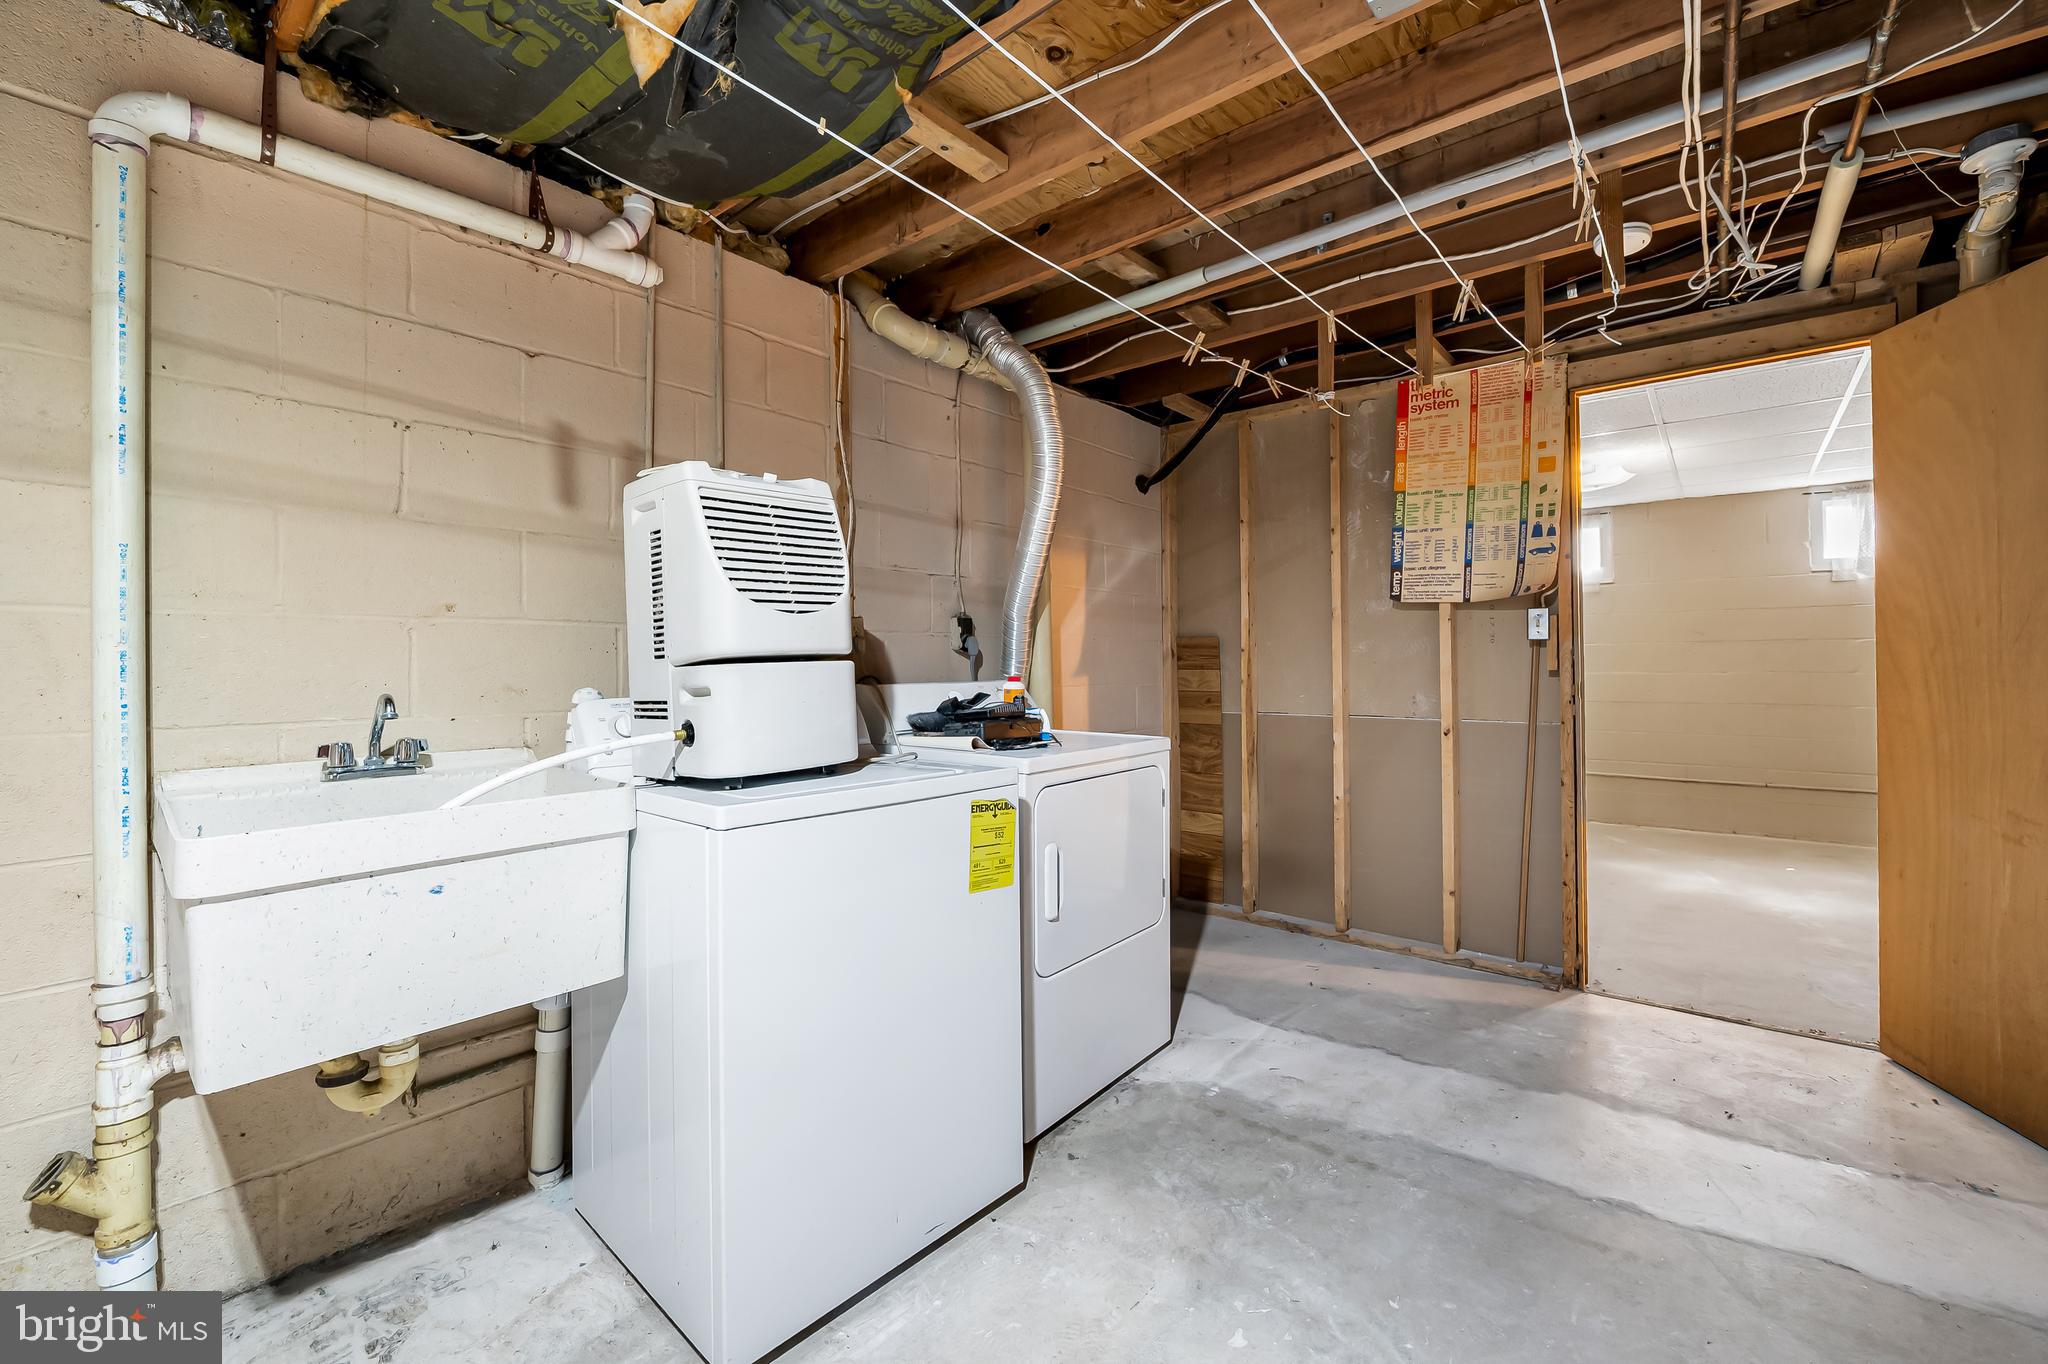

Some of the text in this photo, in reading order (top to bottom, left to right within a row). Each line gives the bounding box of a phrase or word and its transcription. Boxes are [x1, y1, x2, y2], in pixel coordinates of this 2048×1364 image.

[1410, 387, 1453, 402] metric
[1410, 399, 1460, 415] system
[1396, 421, 1408, 451] length
[1397, 462, 1405, 484] area
[1394, 493, 1404, 526] volume
[1392, 531, 1404, 563] weight
[1391, 571, 1402, 596] temp
